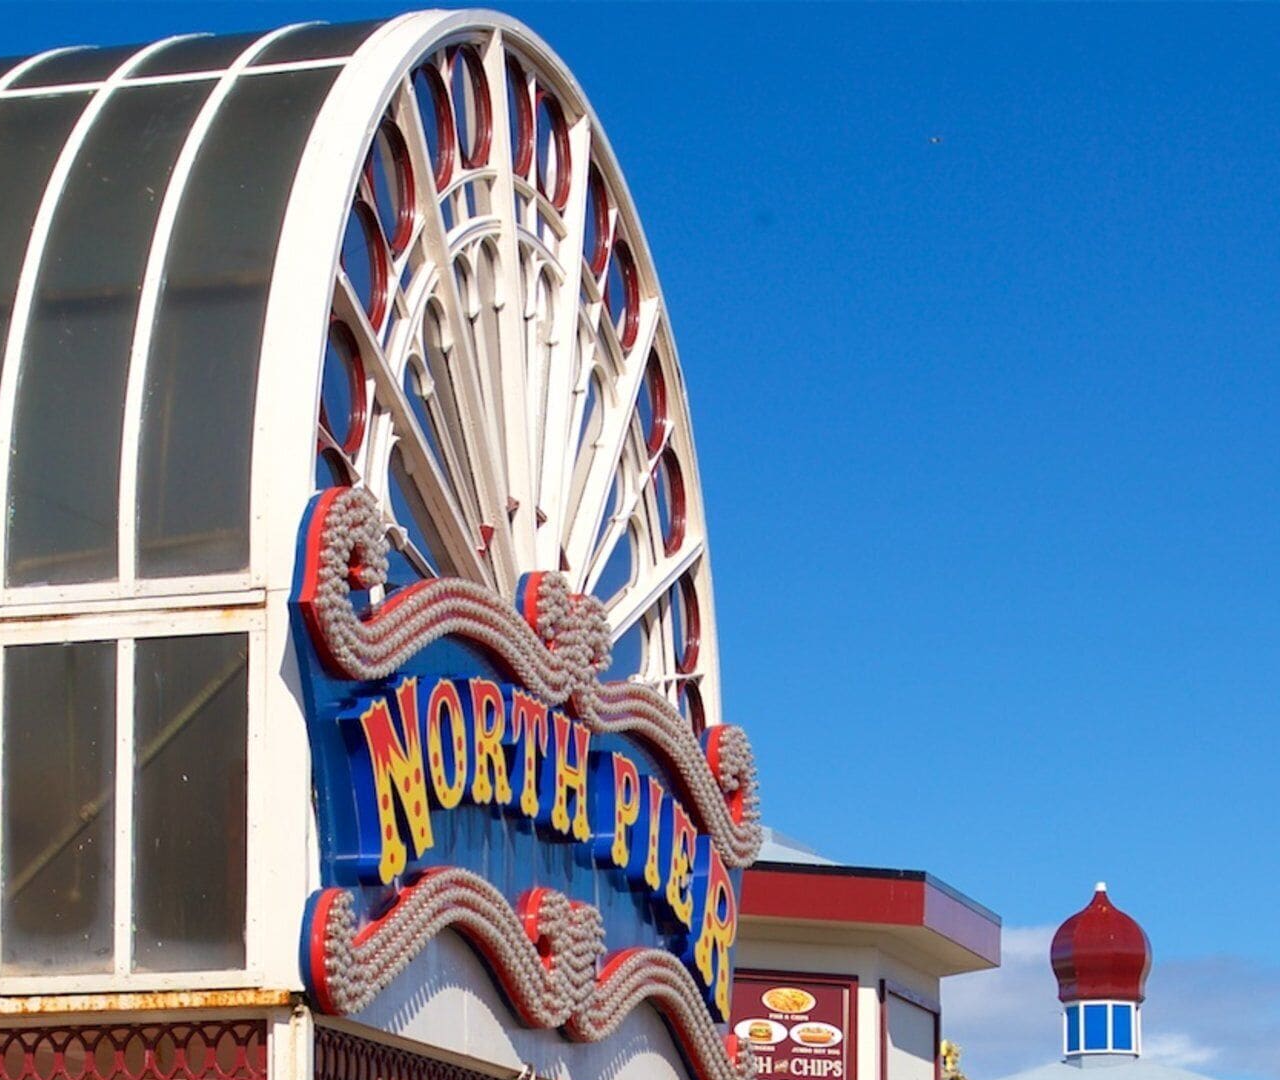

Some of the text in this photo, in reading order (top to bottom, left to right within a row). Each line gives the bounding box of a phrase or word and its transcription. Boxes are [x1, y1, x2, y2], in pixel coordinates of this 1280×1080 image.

[360, 677, 737, 1023] NORTH PIER
[790, 1058, 843, 1077] CHIPS
